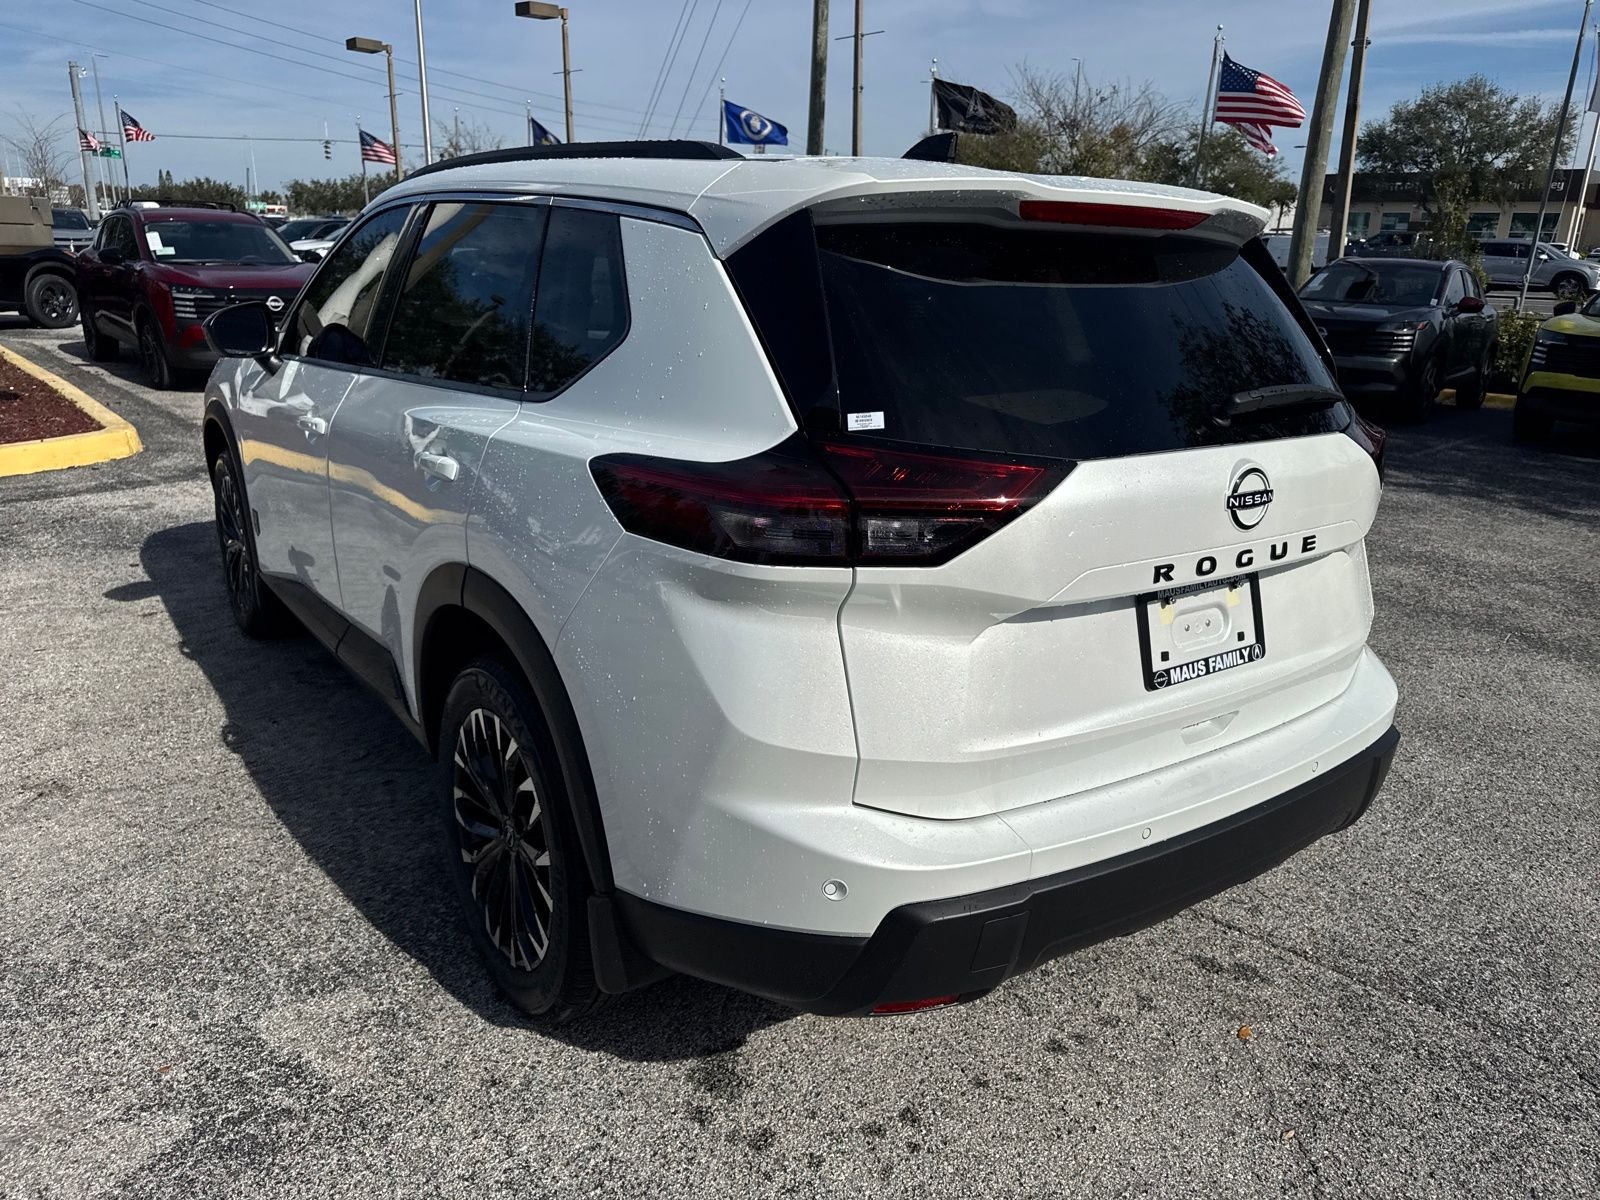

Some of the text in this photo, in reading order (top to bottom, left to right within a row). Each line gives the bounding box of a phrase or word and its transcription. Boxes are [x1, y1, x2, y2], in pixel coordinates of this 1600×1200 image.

[1229, 492, 1273, 507] NISSAN
[1152, 534, 1317, 584] ROGUE
[1169, 647, 1250, 684] MAUS FAMILY
